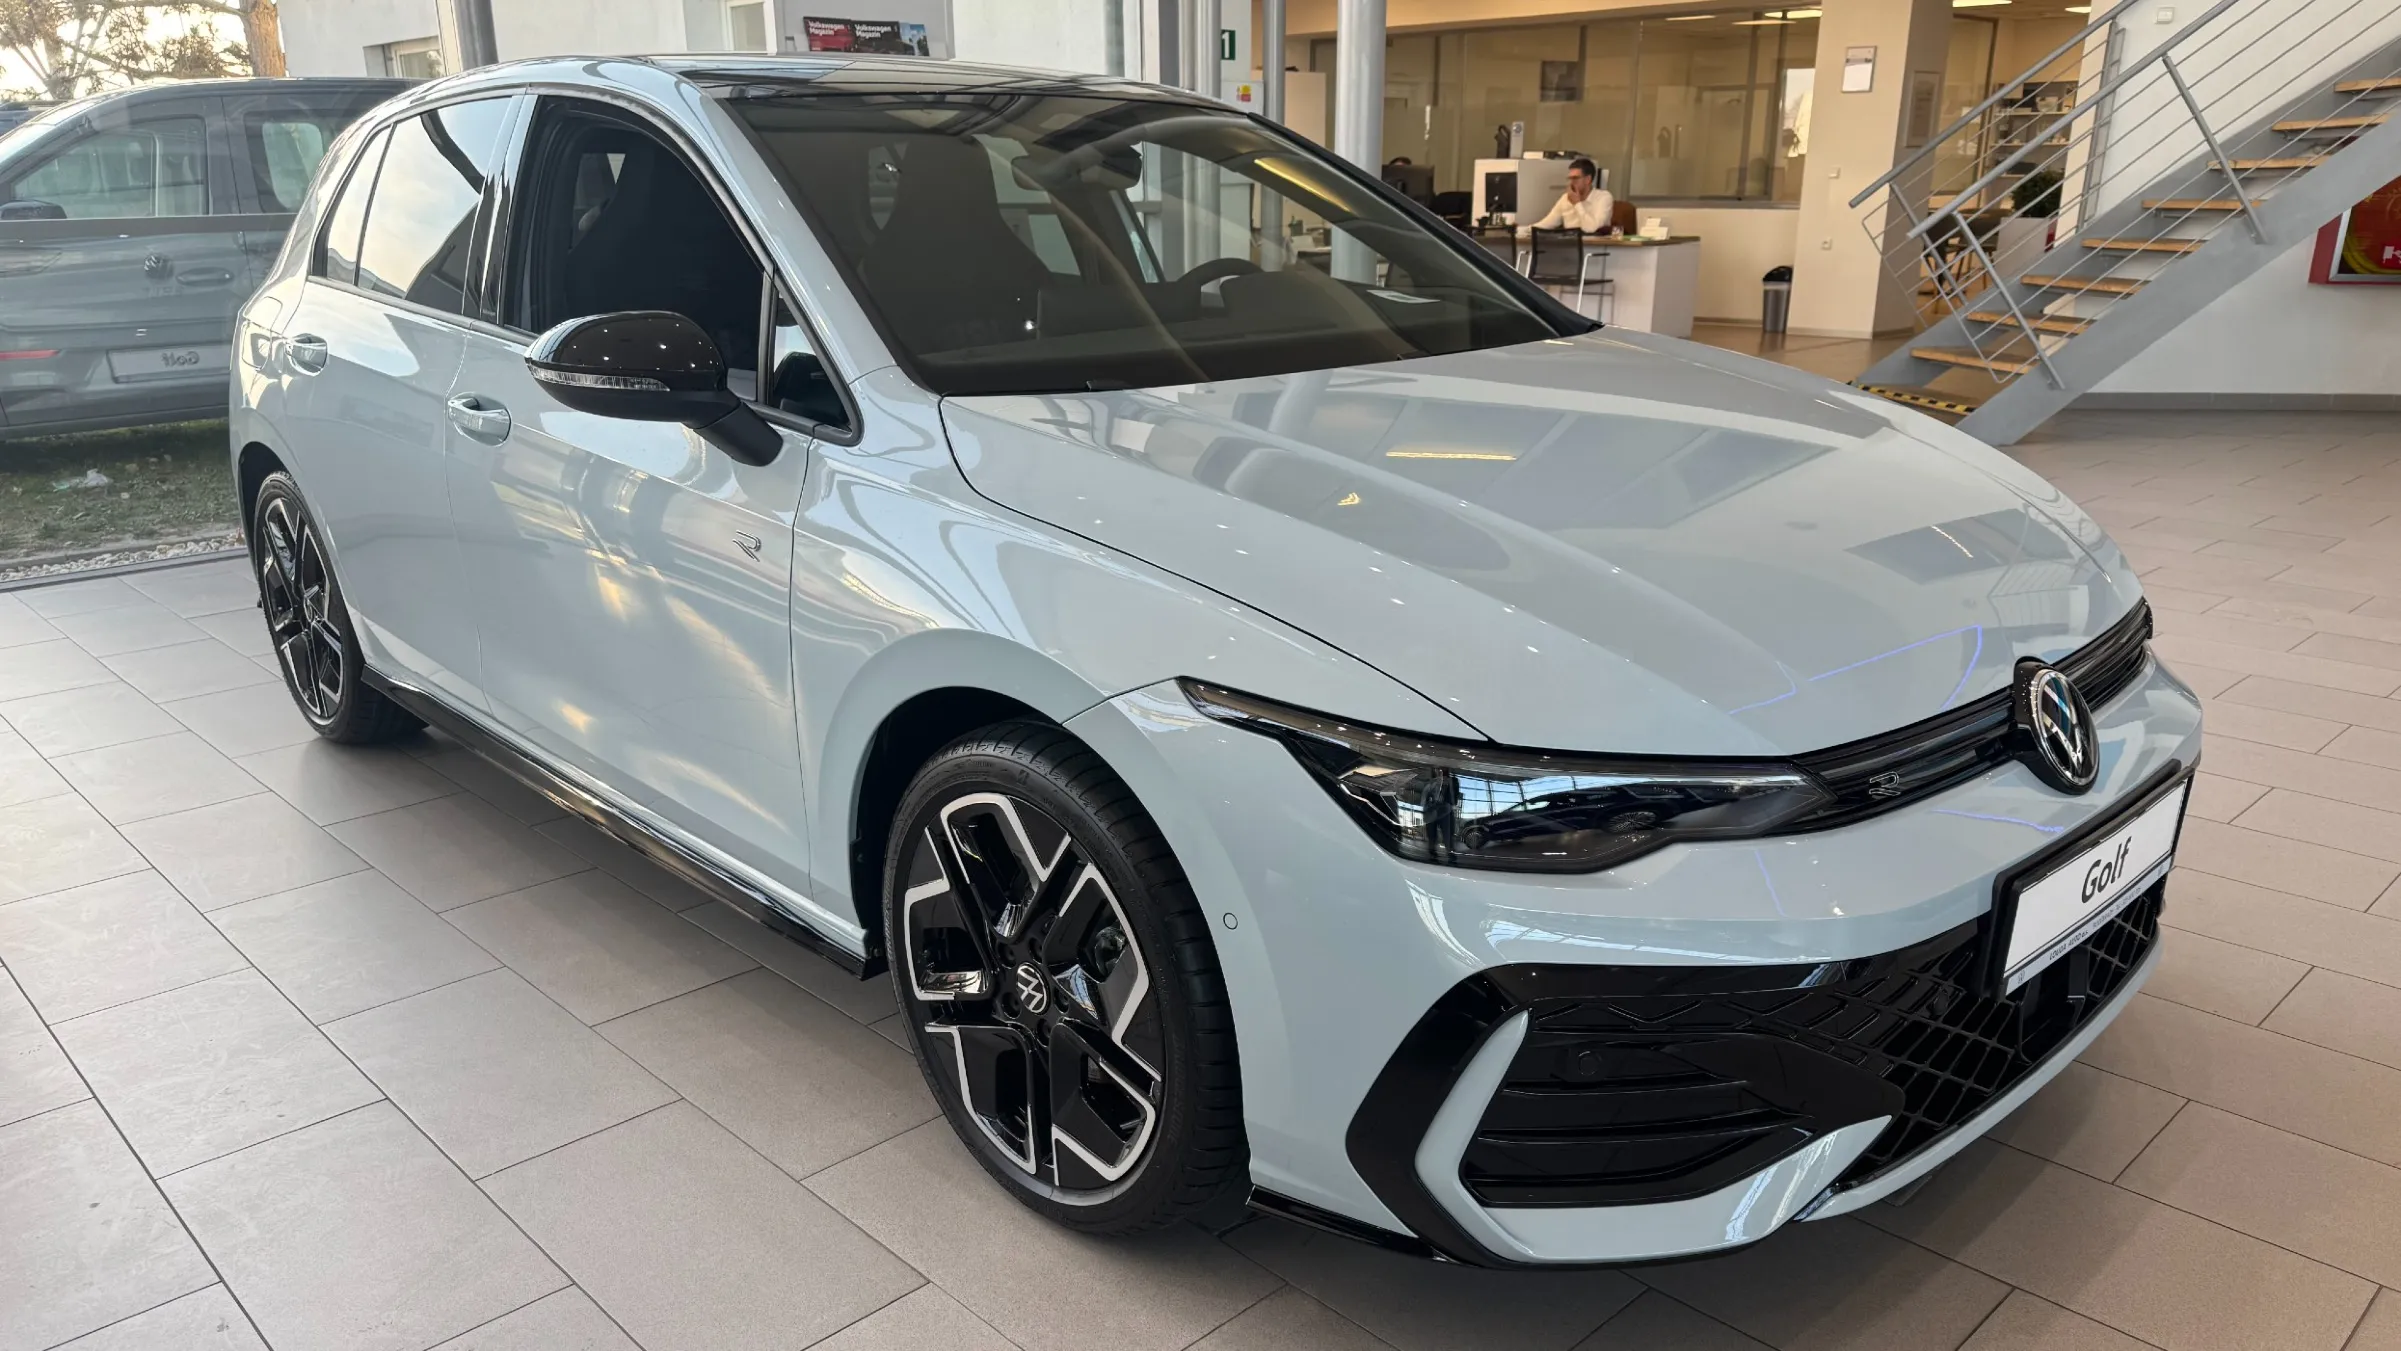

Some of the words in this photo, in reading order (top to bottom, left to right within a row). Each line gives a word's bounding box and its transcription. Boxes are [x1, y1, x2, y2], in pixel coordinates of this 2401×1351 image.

[808, 21, 845, 31] Volkswagen
[855, 24, 892, 34] Volkswagen
[809, 28, 835, 36] Magazin
[855, 30, 881, 39] Magazin
[2081, 836, 2132, 904] Golf
